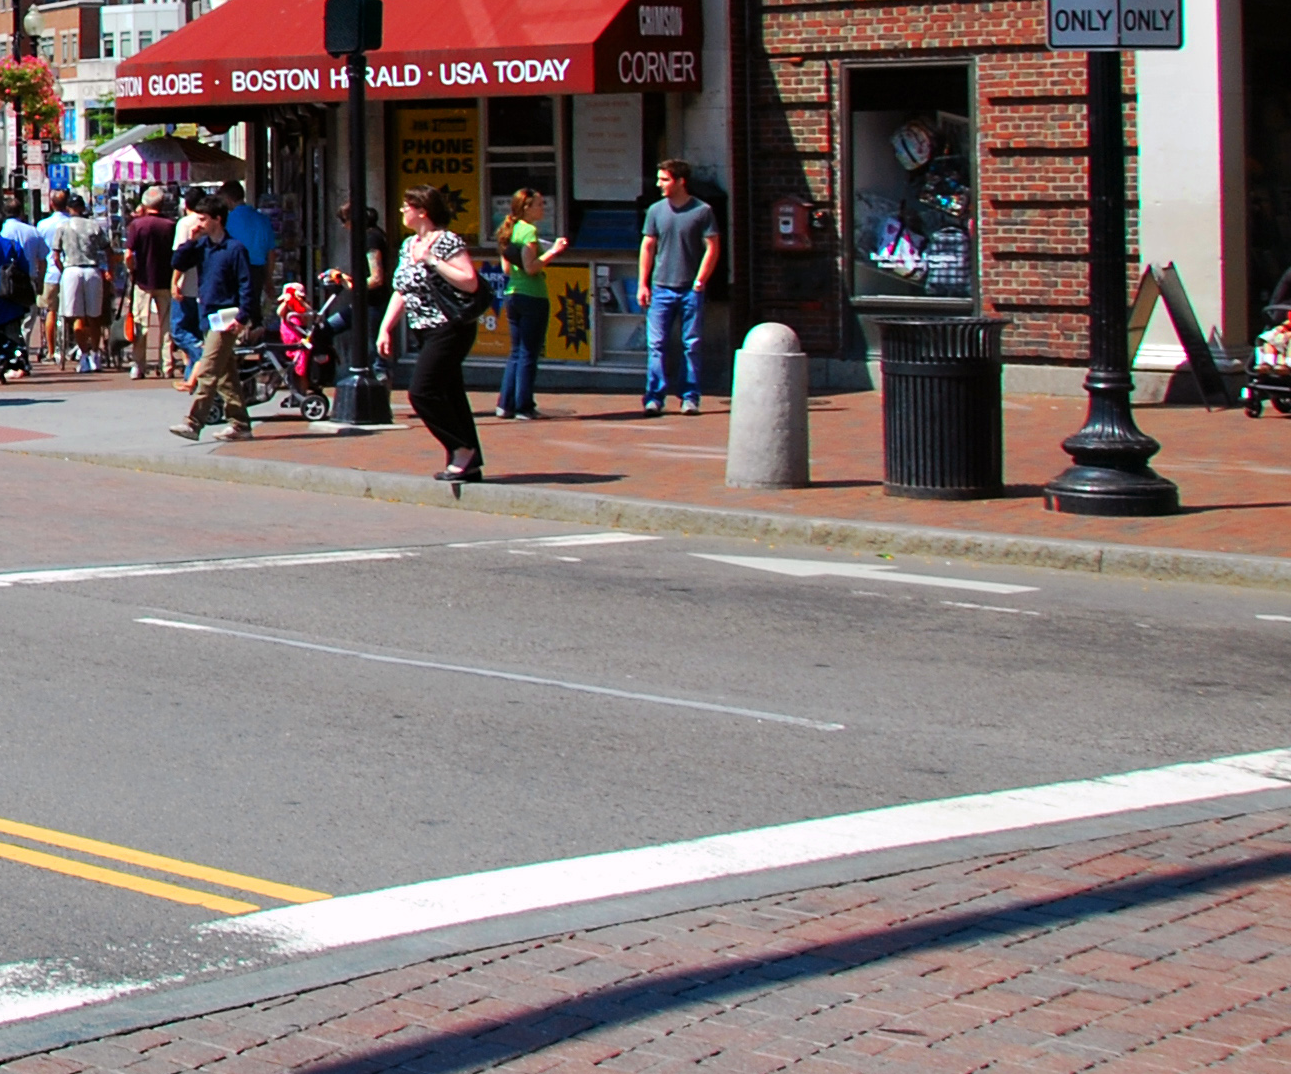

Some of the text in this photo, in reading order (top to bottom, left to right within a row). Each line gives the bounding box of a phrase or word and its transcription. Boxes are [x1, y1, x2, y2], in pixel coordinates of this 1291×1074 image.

[640, 5, 682, 35] CRIMSON
[1055, 9, 1174, 31] ONLY ONLY
[148, 73, 204, 95] GLOBE
[231, 68, 319, 92] BOSTON
[330, 64, 421, 90] HRALD
[439, 62, 488, 85] USA
[492, 58, 571, 83] TODAY
[618, 51, 696, 83] CORNER
[402, 139, 474, 154] PHONE
[52, 166, 64, 179] H
[402, 158, 474, 173] CARDS
